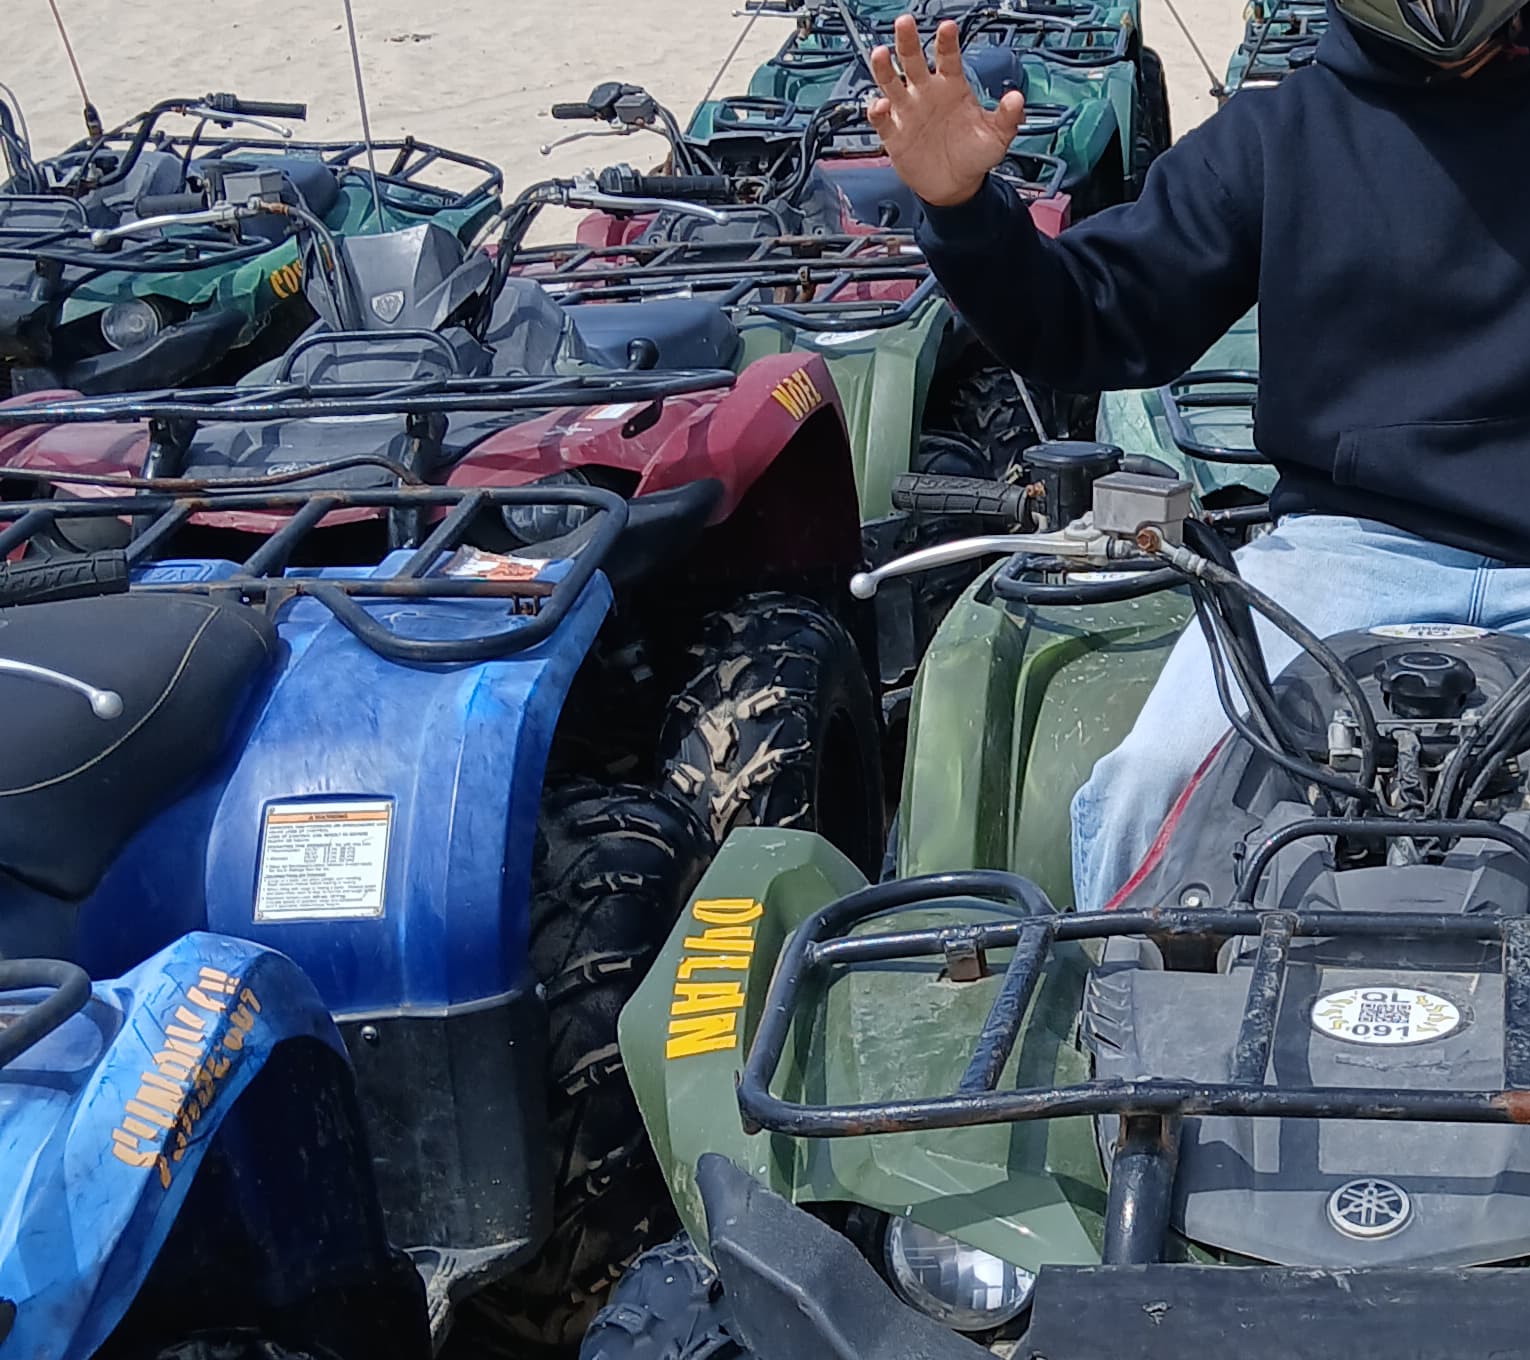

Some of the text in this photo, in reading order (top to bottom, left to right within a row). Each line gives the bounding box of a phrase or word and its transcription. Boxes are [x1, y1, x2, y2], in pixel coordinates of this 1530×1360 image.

[771, 367, 822, 421] NOEL
[665, 897, 764, 1060] DYLAN
[1361, 991, 1410, 1004] QL
[1351, 1023, 1410, 1038] 091
